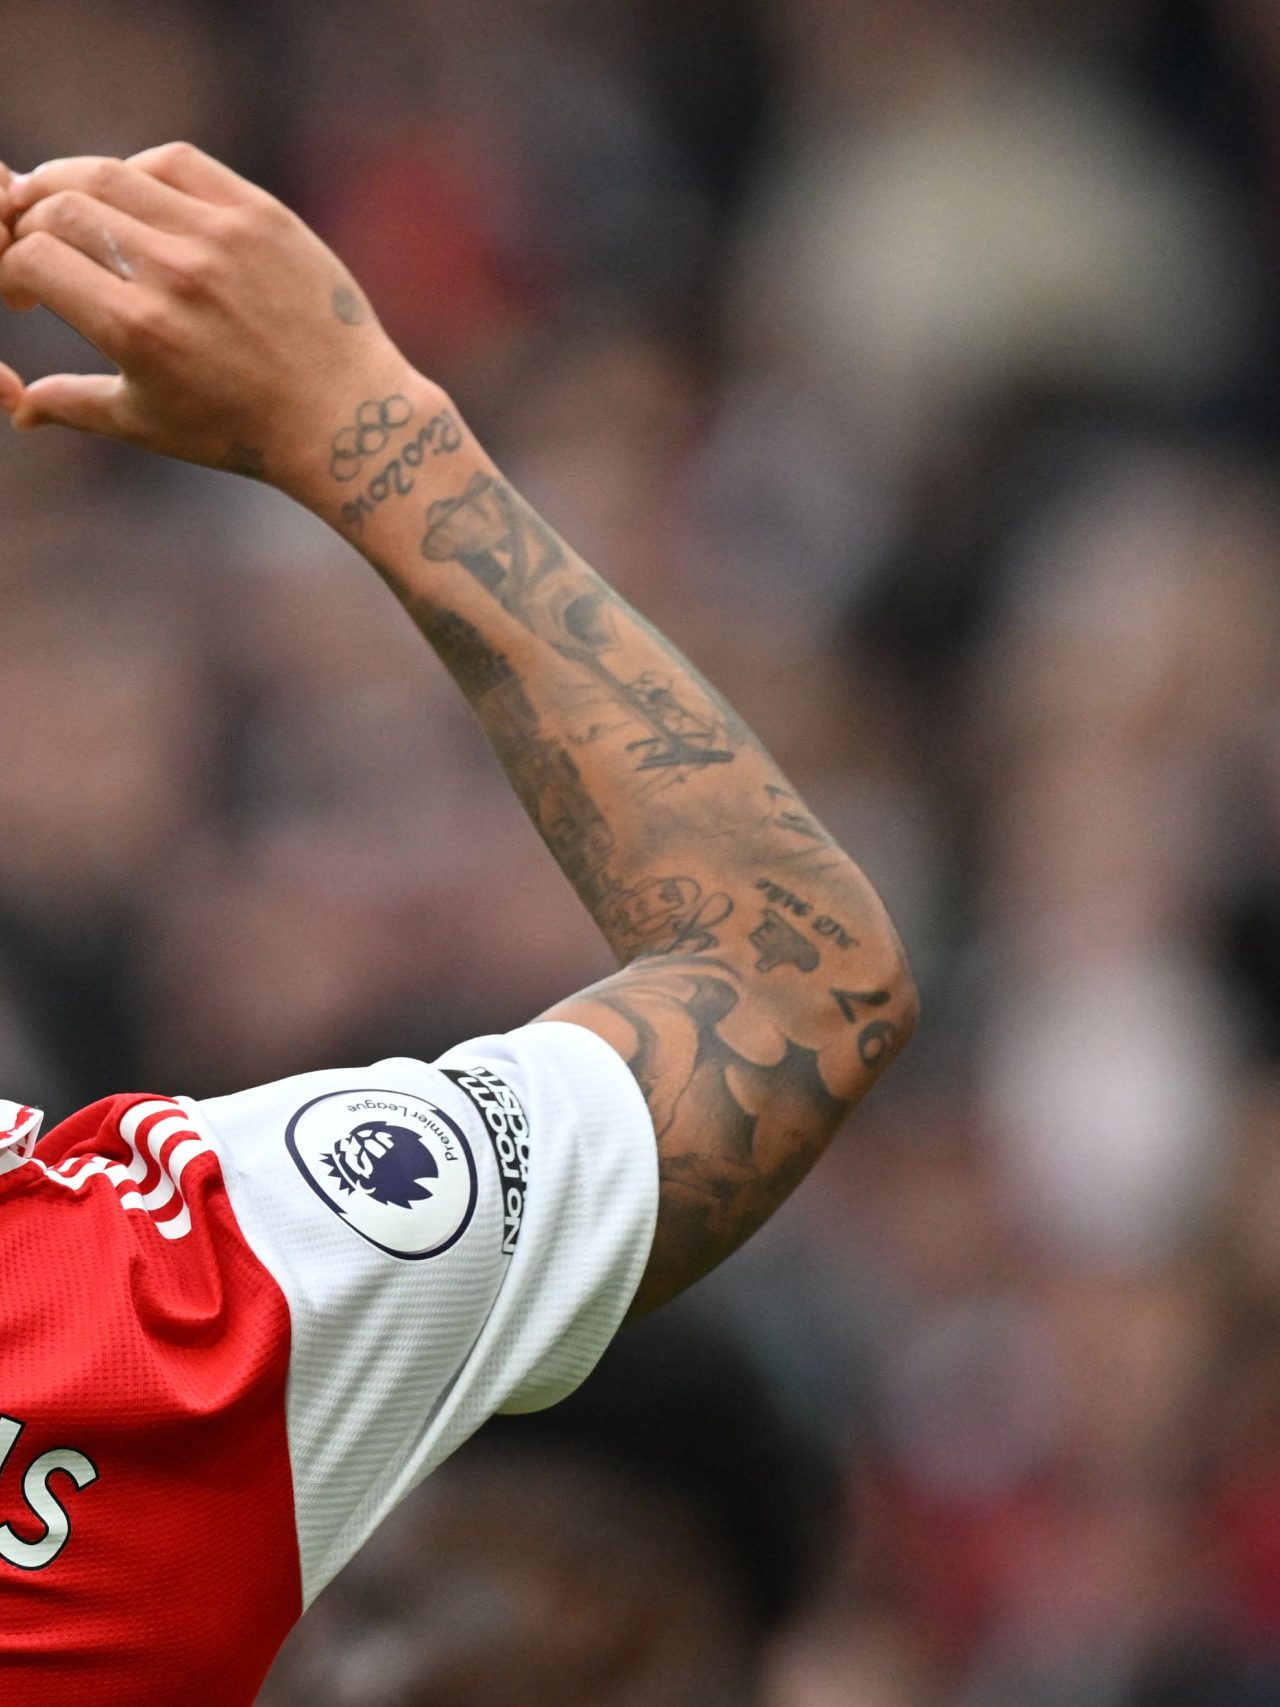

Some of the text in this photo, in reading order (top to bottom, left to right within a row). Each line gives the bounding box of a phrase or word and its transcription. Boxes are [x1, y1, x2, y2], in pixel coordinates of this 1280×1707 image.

[347, 1100, 458, 1162] Premier League
[457, 1075, 522, 1253] No room
